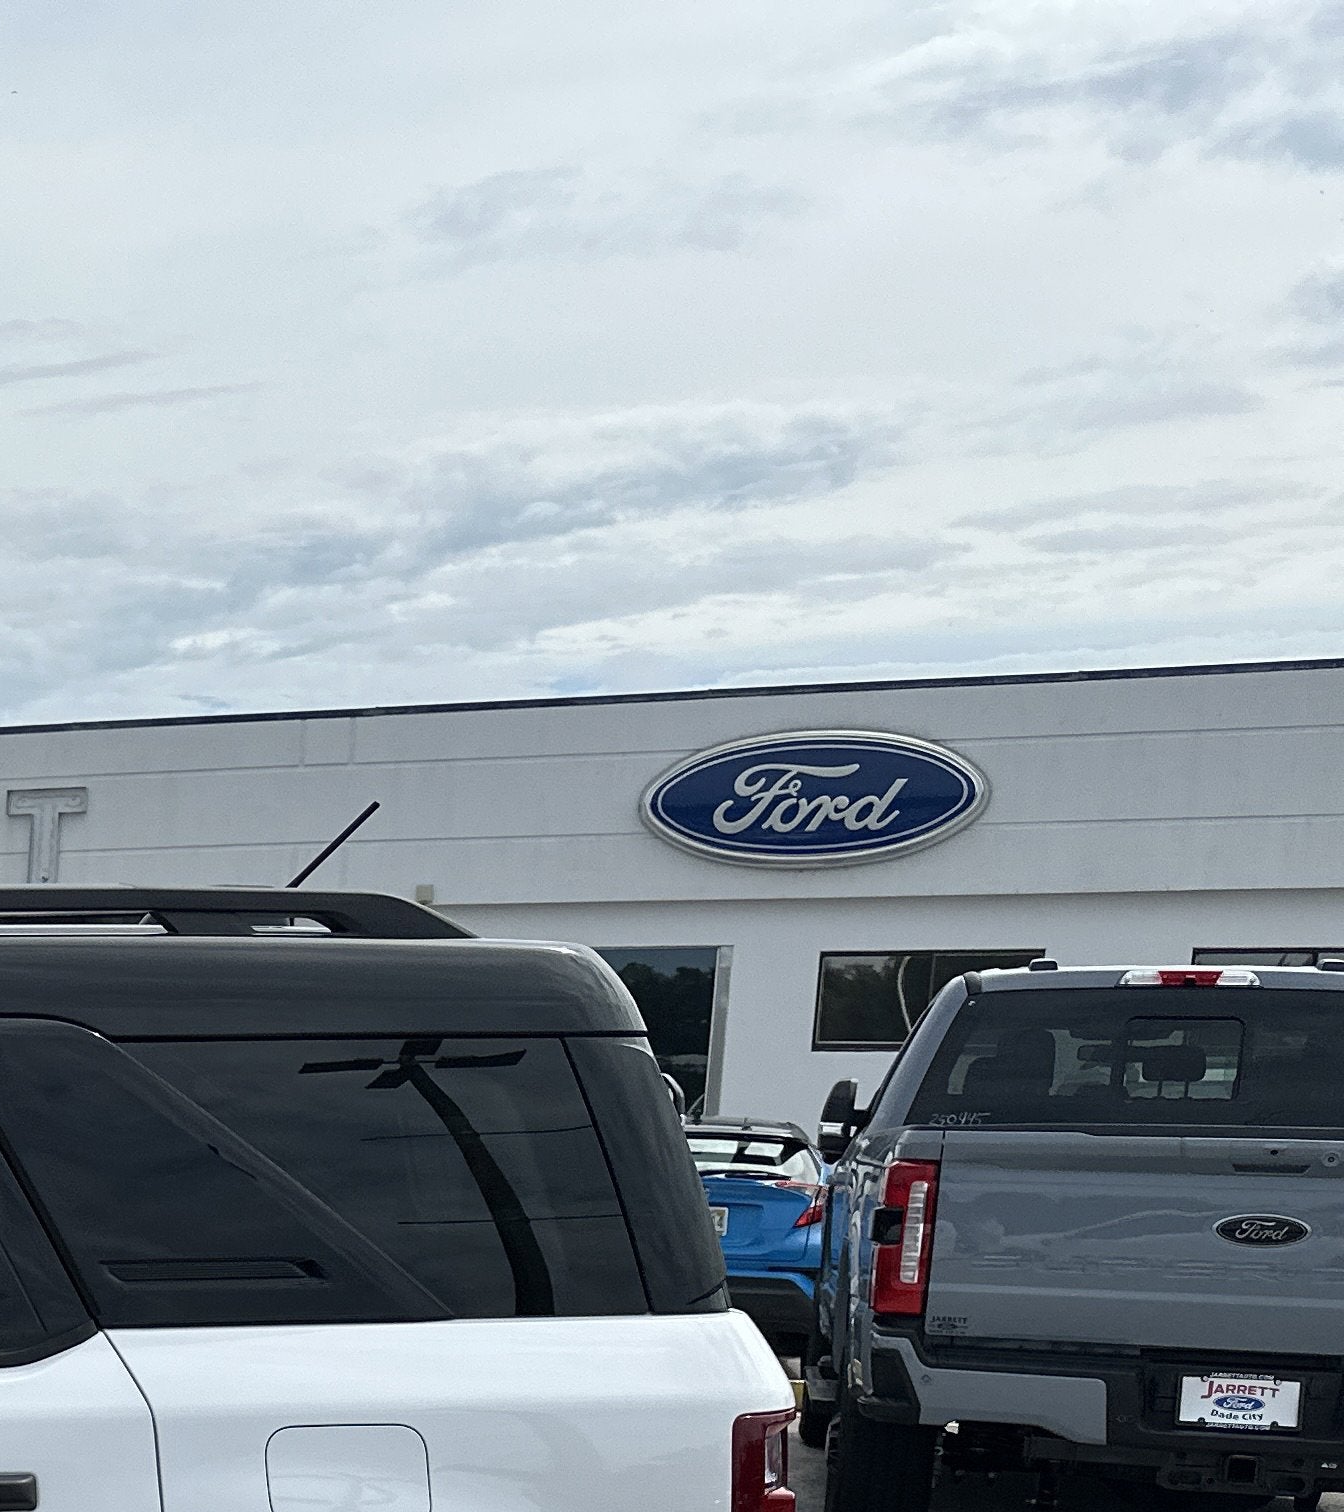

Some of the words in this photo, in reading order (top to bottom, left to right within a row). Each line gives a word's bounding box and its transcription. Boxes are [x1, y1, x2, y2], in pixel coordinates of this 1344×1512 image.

[713, 763, 909, 834] Ford
[1235, 1220, 1289, 1240] Ford
[1201, 1381, 1280, 1399] JARRETT
[1223, 1398, 1256, 1410] Ford
[1211, 1409, 1239, 1421] Dade
[1242, 1413, 1264, 1421] City
